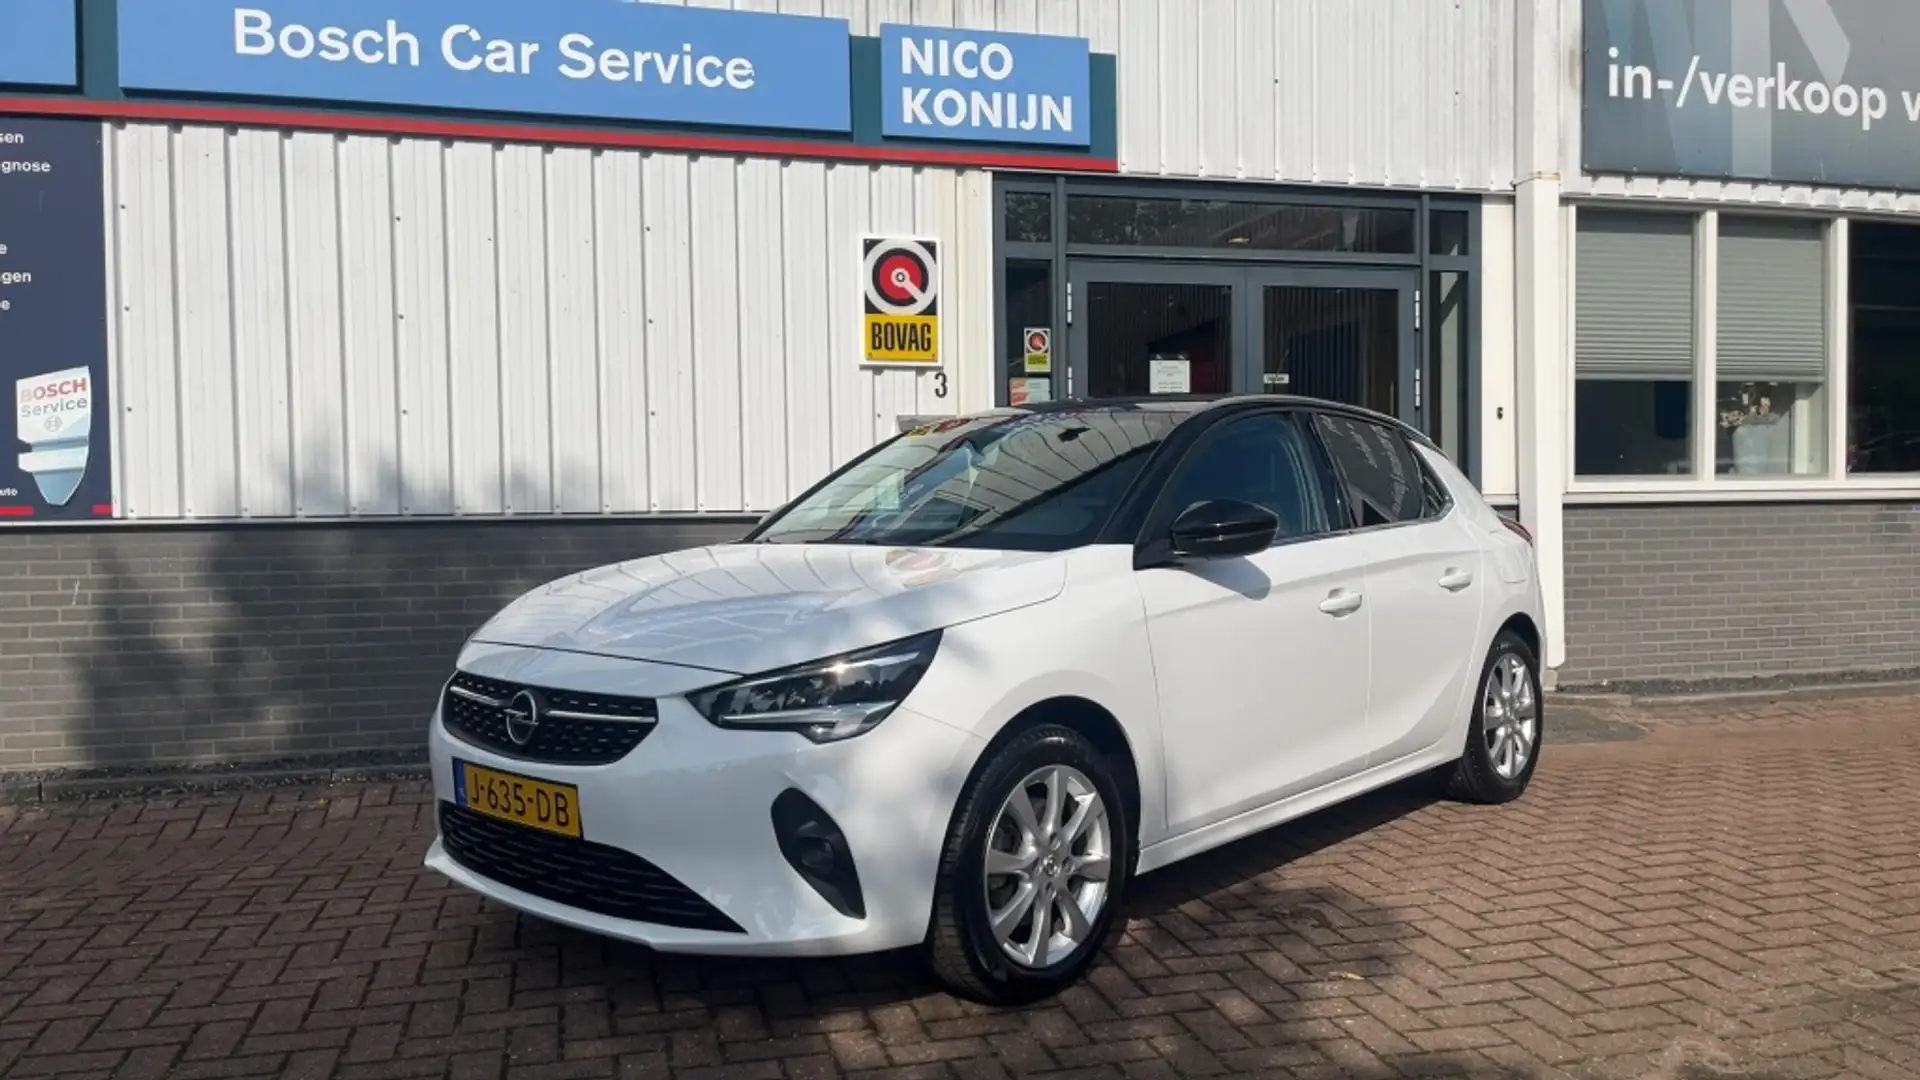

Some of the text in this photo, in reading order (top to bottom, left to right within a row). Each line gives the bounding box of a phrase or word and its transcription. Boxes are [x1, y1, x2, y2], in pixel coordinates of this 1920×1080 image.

[234, 8, 755, 90] Bosch Car Service
[901, 37, 1014, 80] NICO
[1608, 46, 1887, 131] in-/verkoop
[902, 86, 1072, 132] KONIJN
[0, 161, 51, 174] gnose
[871, 322, 932, 352] BOVAG
[20, 377, 88, 404] BOSCH
[934, 372, 948, 398] 3
[20, 397, 88, 418] Service
[472, 773, 569, 828] J-635-DB
